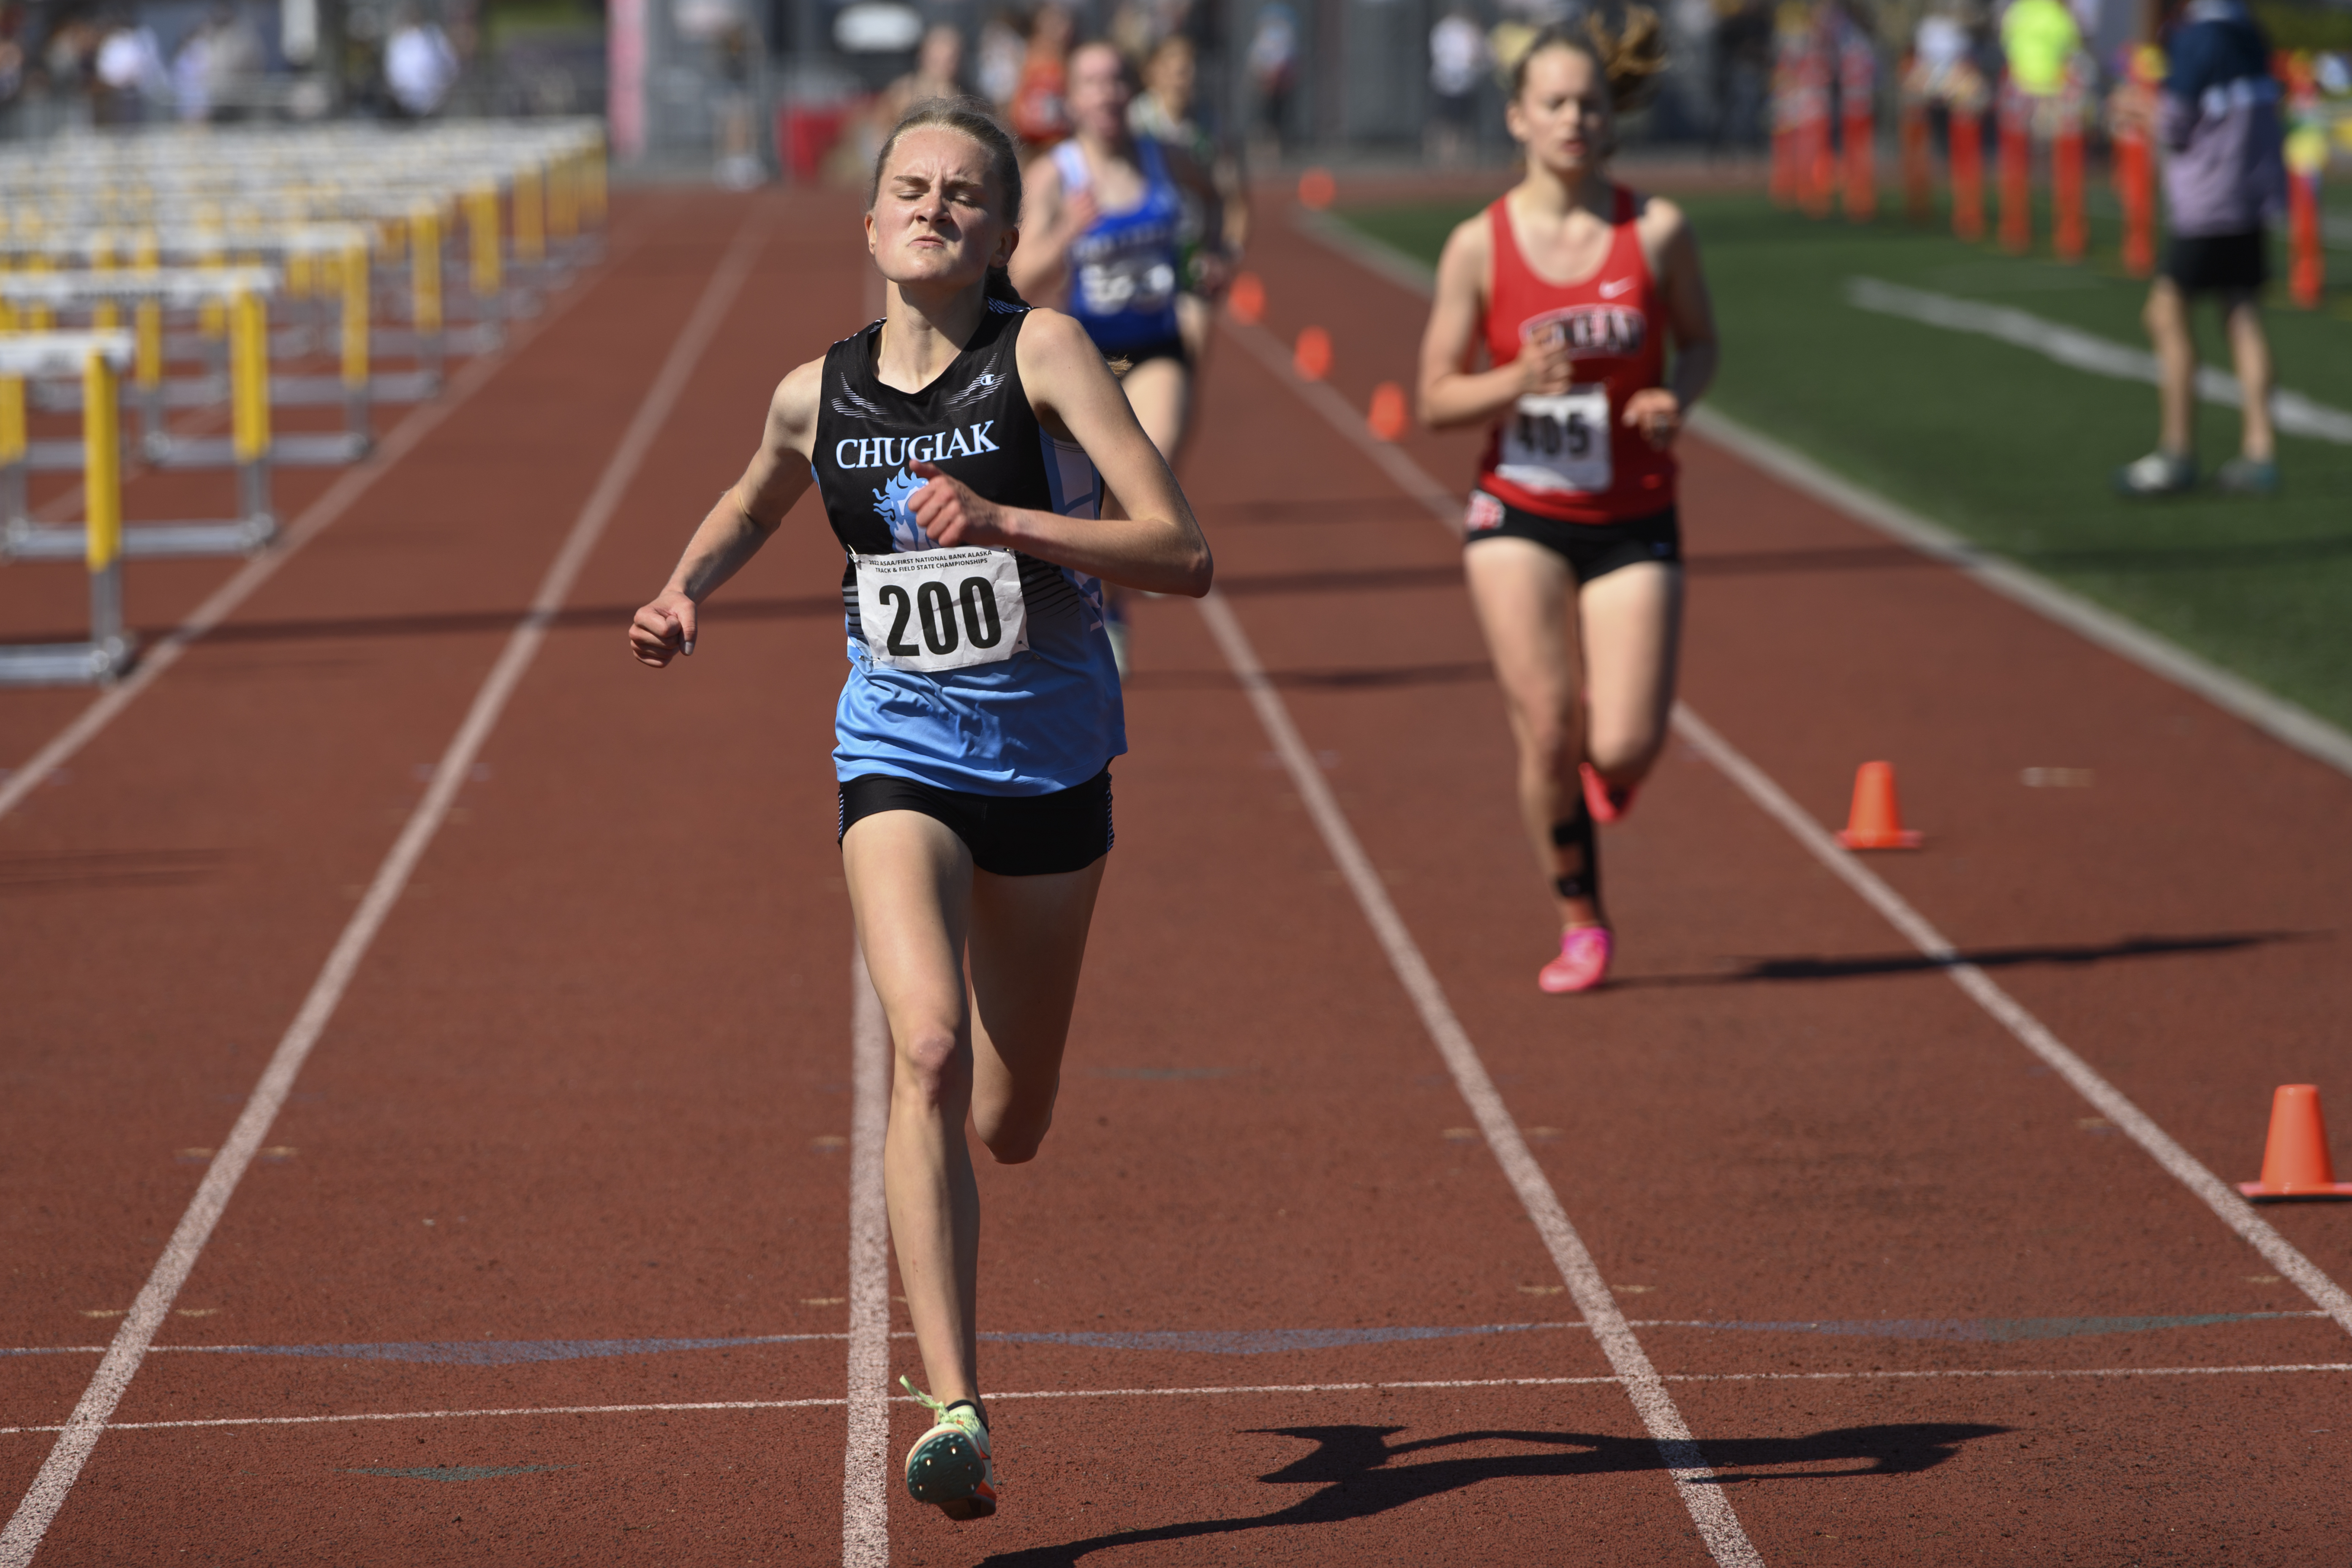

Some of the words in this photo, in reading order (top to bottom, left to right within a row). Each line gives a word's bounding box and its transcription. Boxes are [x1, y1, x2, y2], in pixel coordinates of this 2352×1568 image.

[836, 420, 1000, 469] CHUGIAK
[936, 558, 988, 568] CHAMPIONSHIPS
[879, 576, 1002, 657] 200
